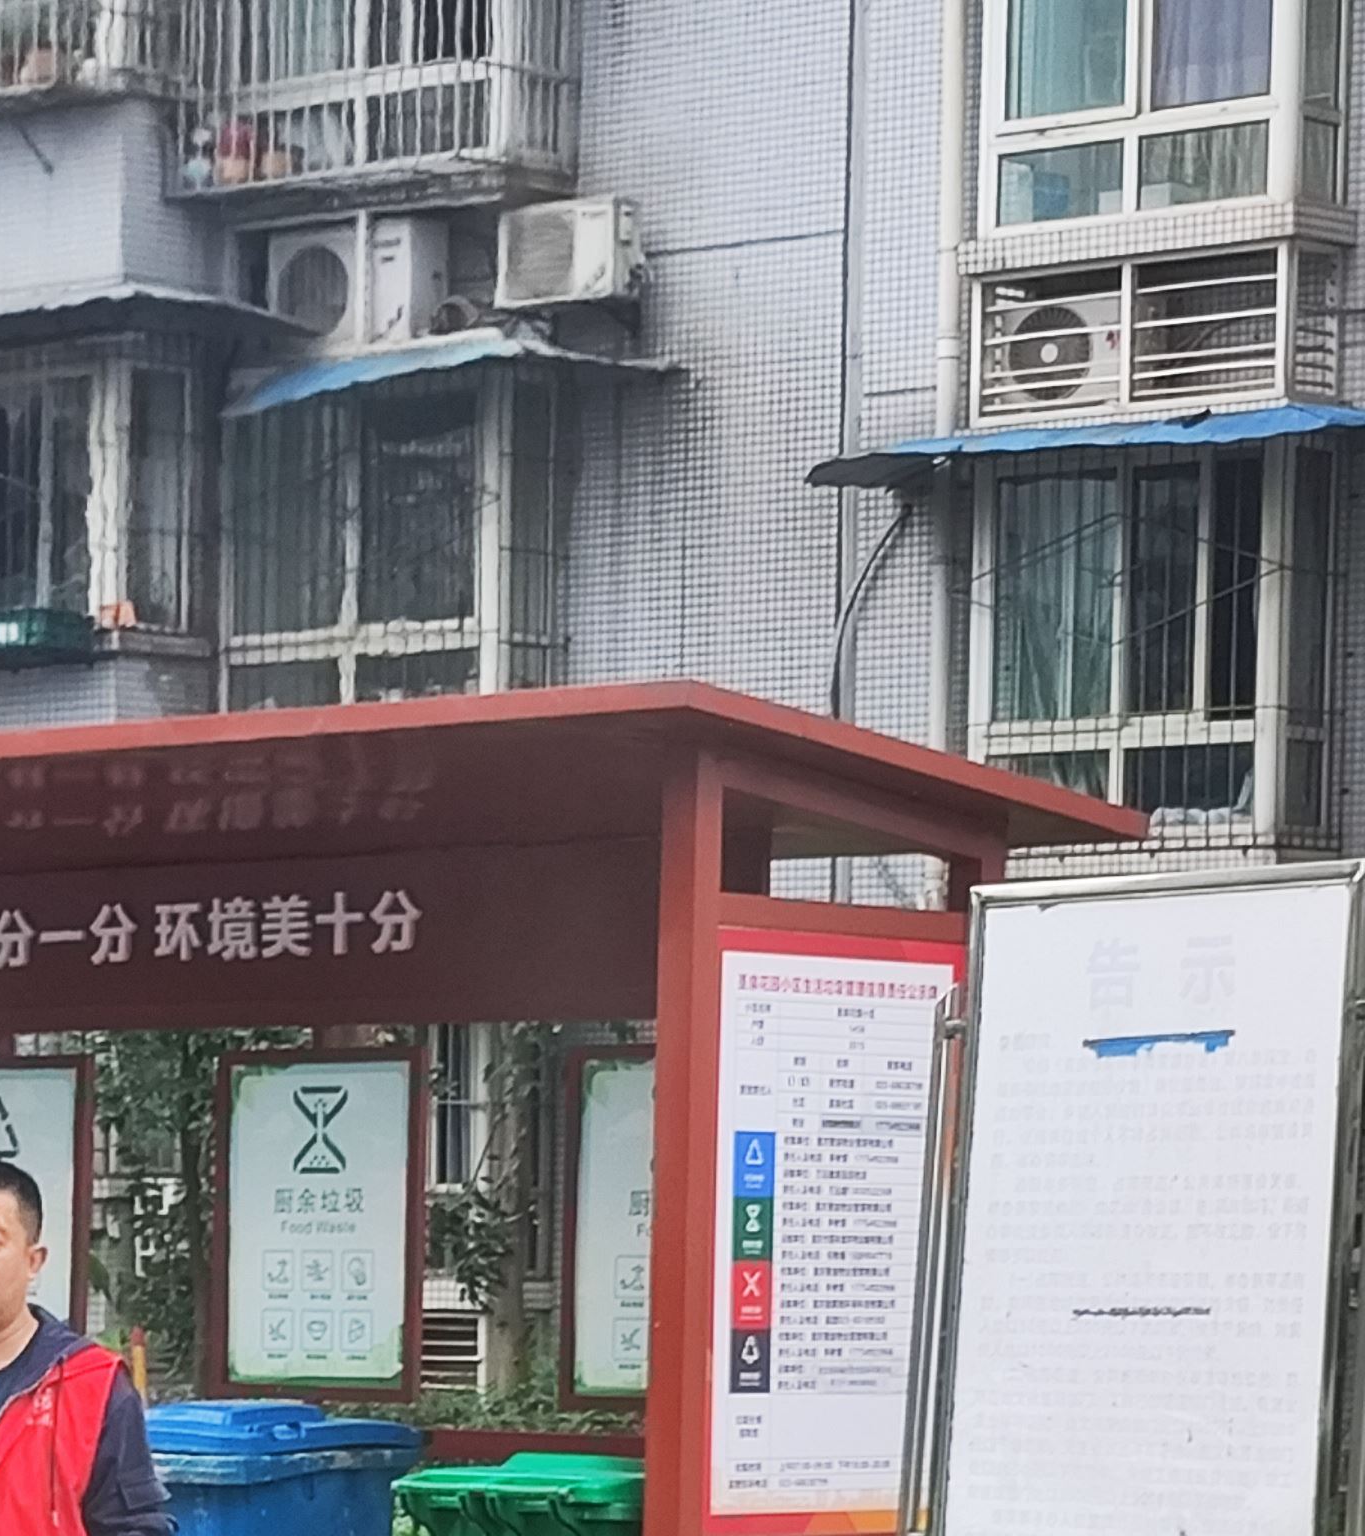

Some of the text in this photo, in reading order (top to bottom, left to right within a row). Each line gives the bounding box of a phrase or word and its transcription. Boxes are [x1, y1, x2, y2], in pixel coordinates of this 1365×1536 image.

[153, 889, 423, 962] 环境美十分
[273, 1188, 365, 1214] 厨余垃圾
[280, 1219, 313, 1235] Food
